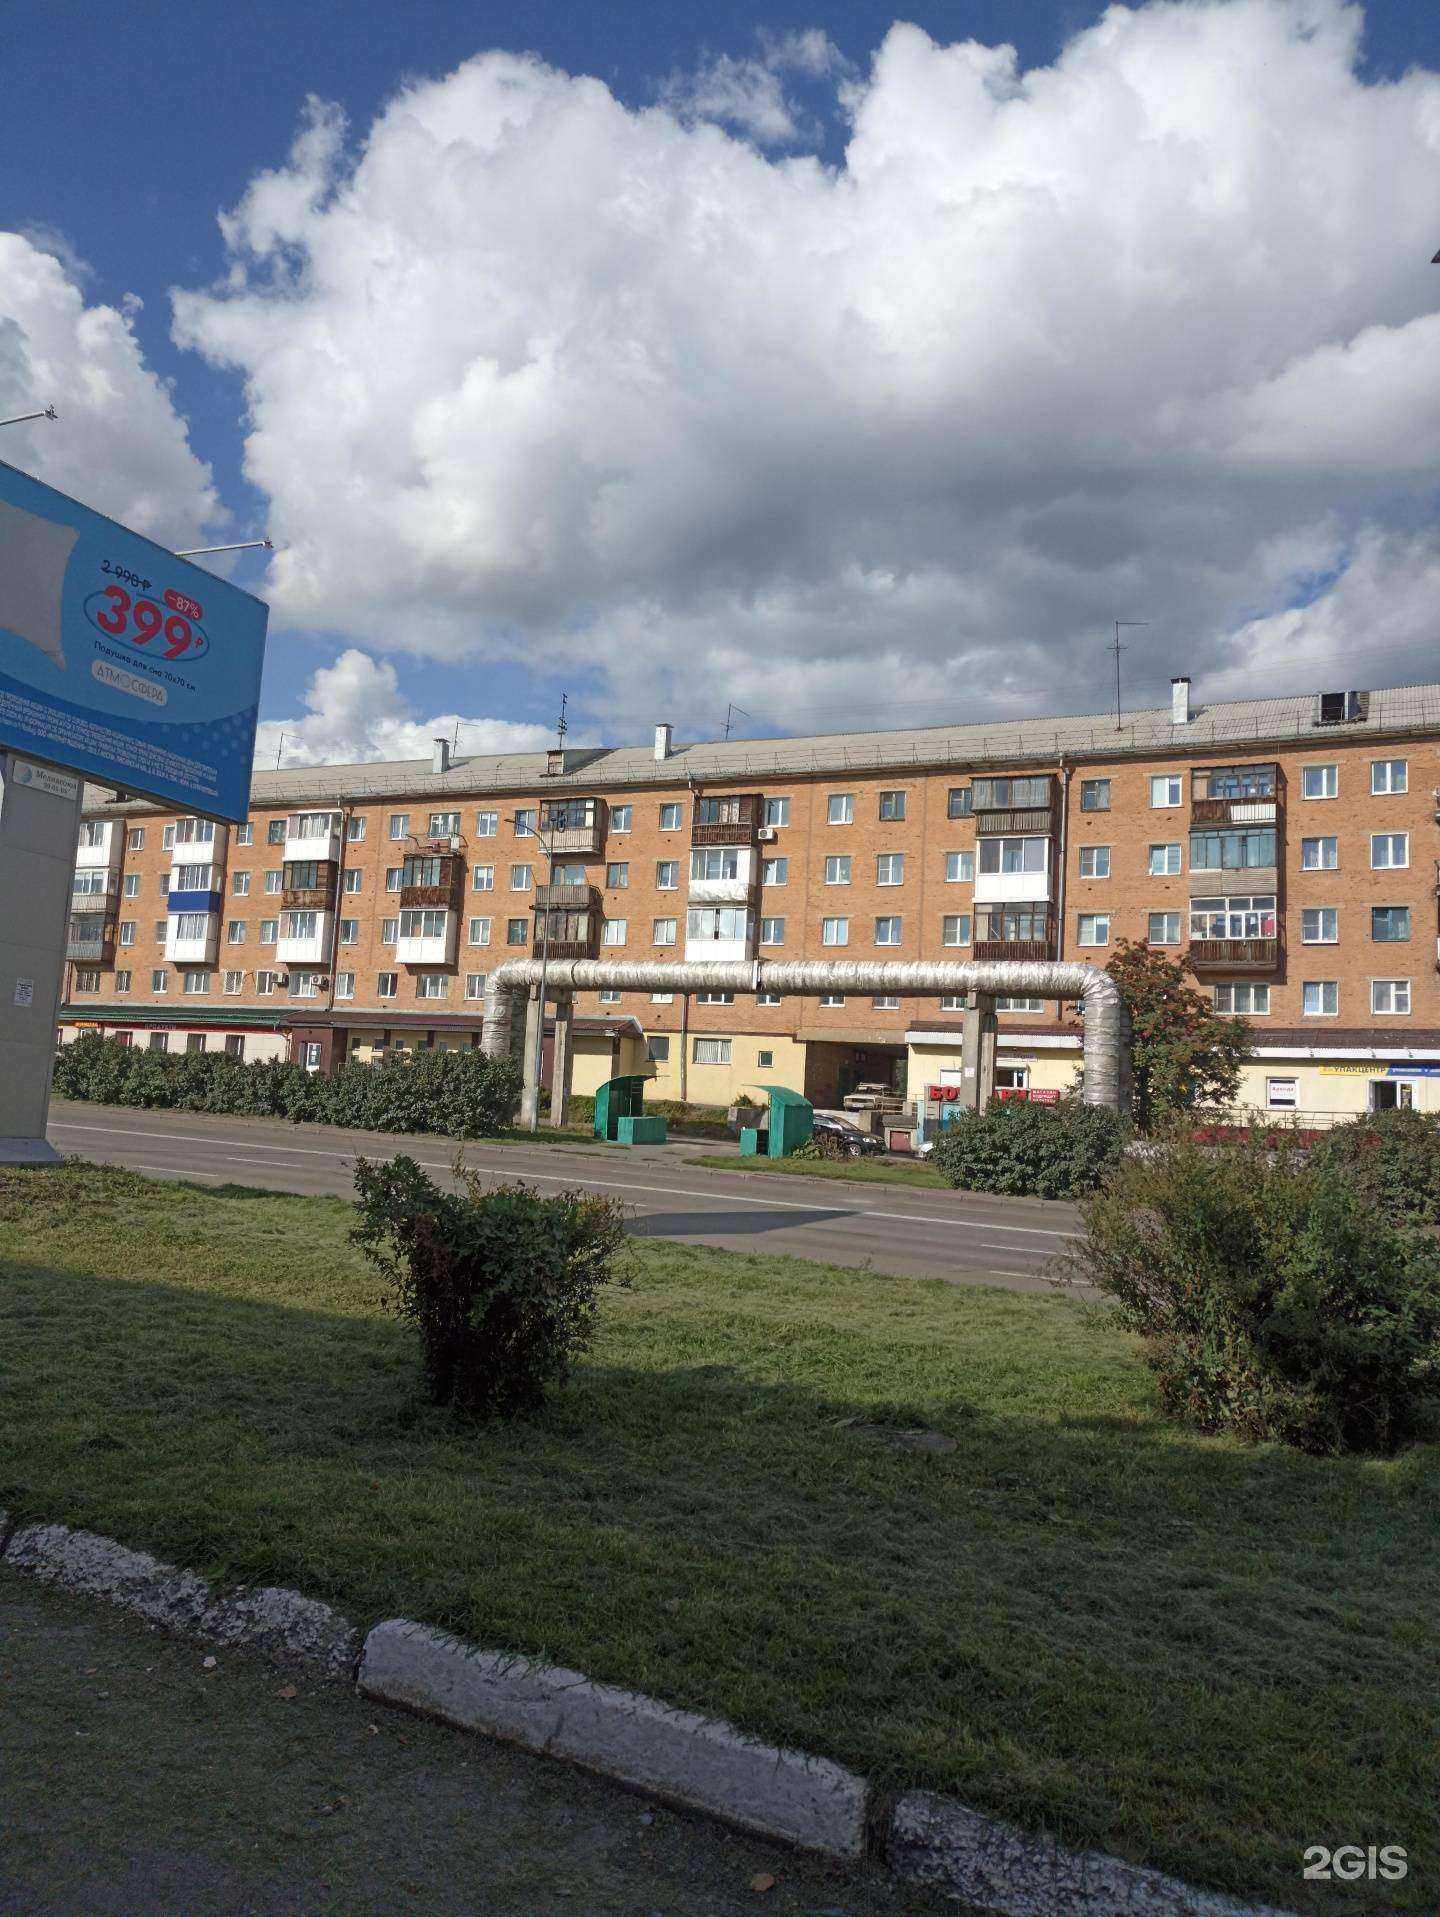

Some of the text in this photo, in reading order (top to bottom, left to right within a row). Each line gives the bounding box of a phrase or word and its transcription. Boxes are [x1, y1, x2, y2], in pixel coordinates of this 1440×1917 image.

[168, 596, 200, 618] -87%
[97, 585, 192, 660] 399
[94, 641, 131, 664] Подушка
[132, 661, 148, 671] для
[149, 667, 163, 677] сна
[97, 666, 163, 702] АТМОСФЕРА
[145, 1022, 177, 1031] ПРОДУКТЫ
[1333, 1066, 1386, 1074] УПАКЦЕНТР
